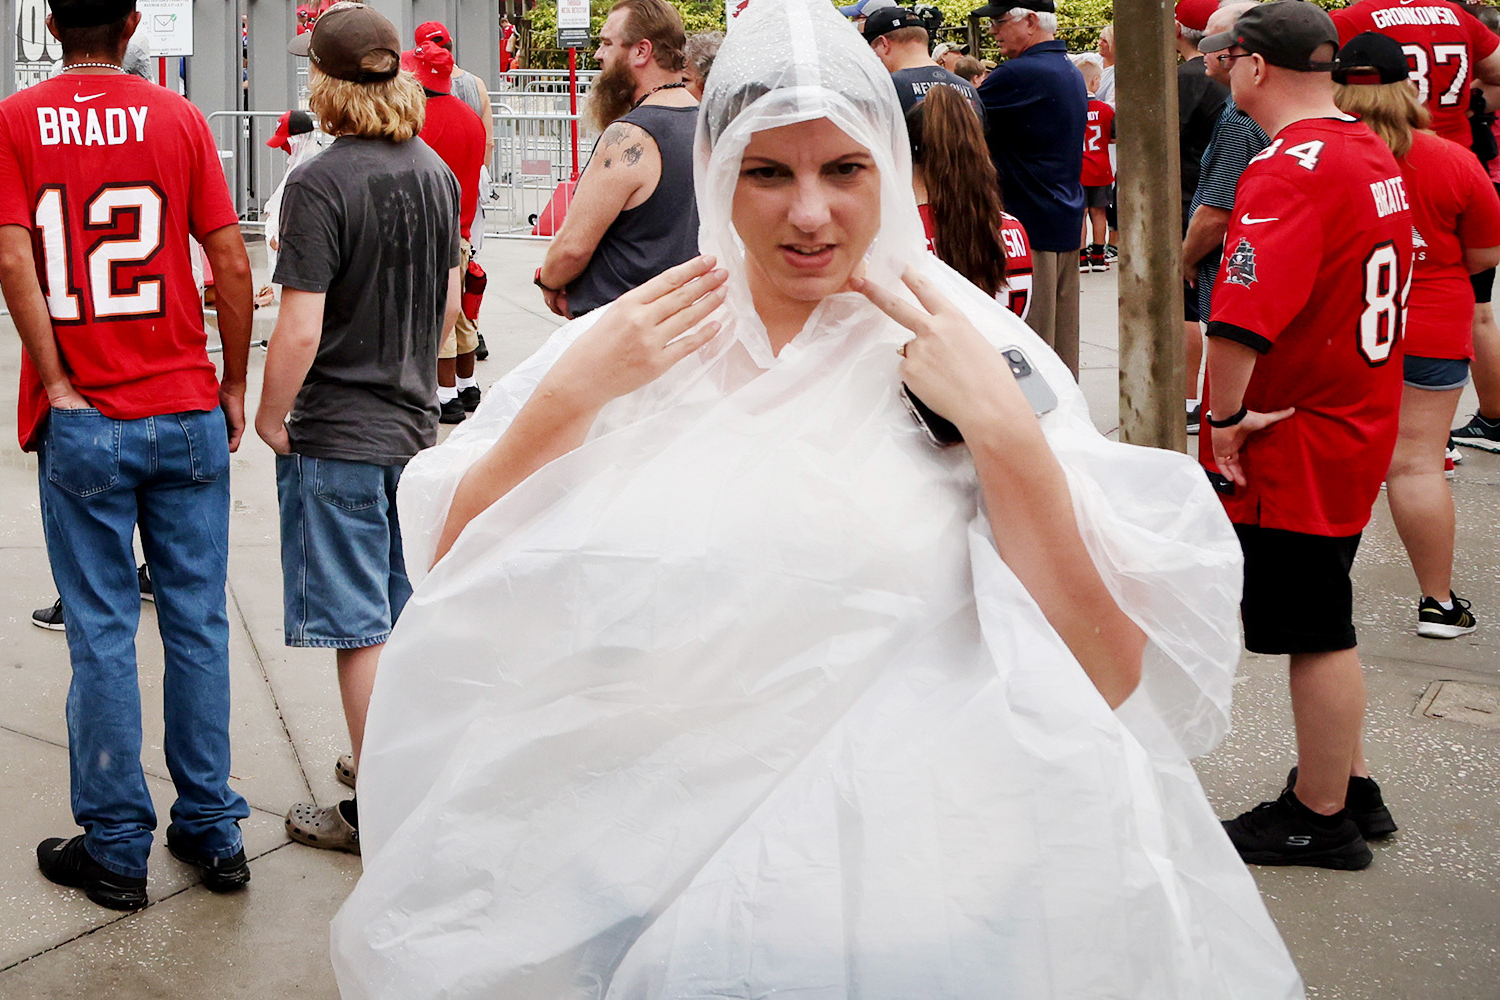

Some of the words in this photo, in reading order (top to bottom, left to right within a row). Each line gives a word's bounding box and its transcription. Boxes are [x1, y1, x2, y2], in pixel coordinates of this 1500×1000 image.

[1371, 5, 1460, 30] GRONKOWSKI
[37, 106, 148, 146] BRADY
[1370, 176, 1409, 218] BRATE
[35, 182, 166, 325] 12
[1357, 240, 1414, 368] 8
